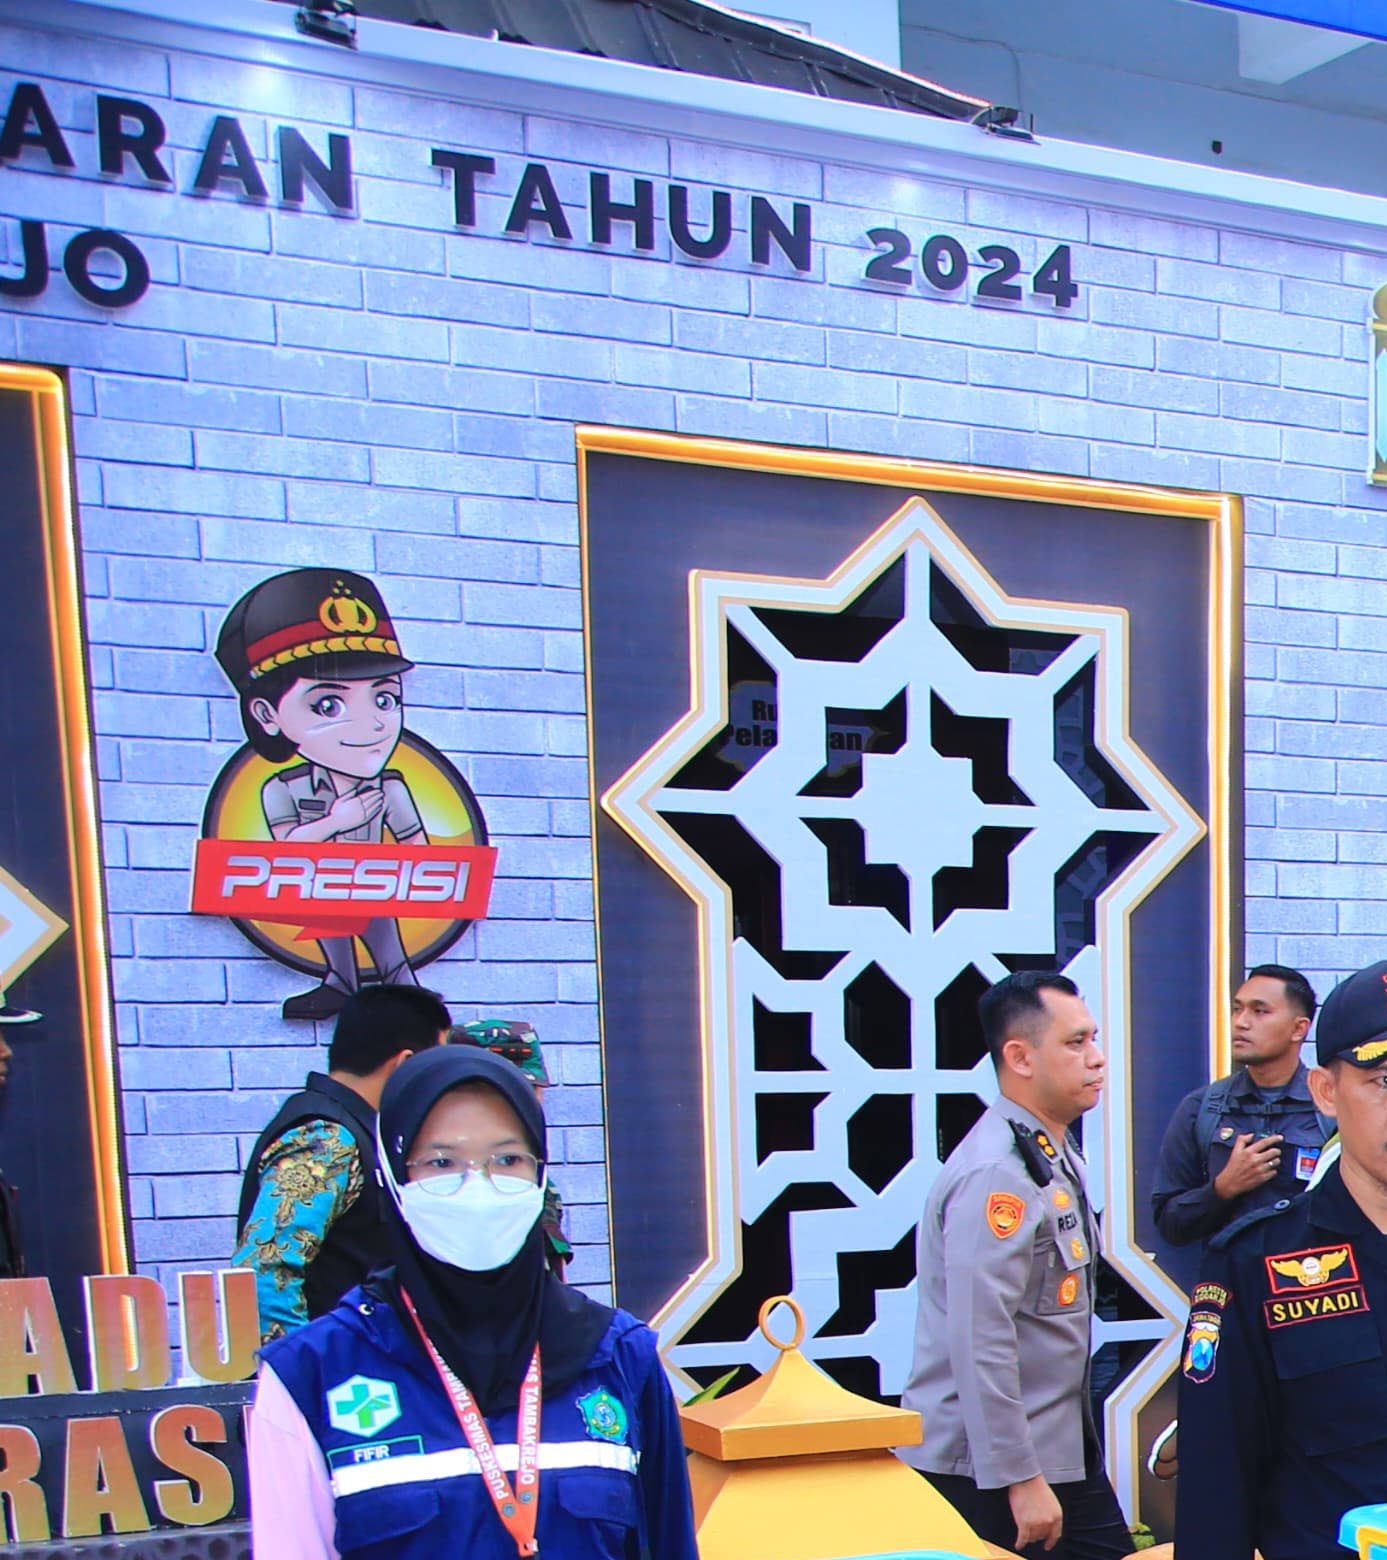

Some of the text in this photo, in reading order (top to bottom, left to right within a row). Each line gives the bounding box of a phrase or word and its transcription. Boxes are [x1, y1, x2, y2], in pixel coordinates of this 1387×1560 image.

[0, 82, 1079, 309] ARAN TAHUN 2024
[0, 219, 150, 309] JO
[221, 855, 472, 903] PRESISI
[0, 1268, 261, 1396] ADU
[1272, 1291, 1359, 1322] SUYADI
[464, 1412, 510, 1500] PUSKESMAS
[520, 1386, 539, 1485] TAMBAKREJO
